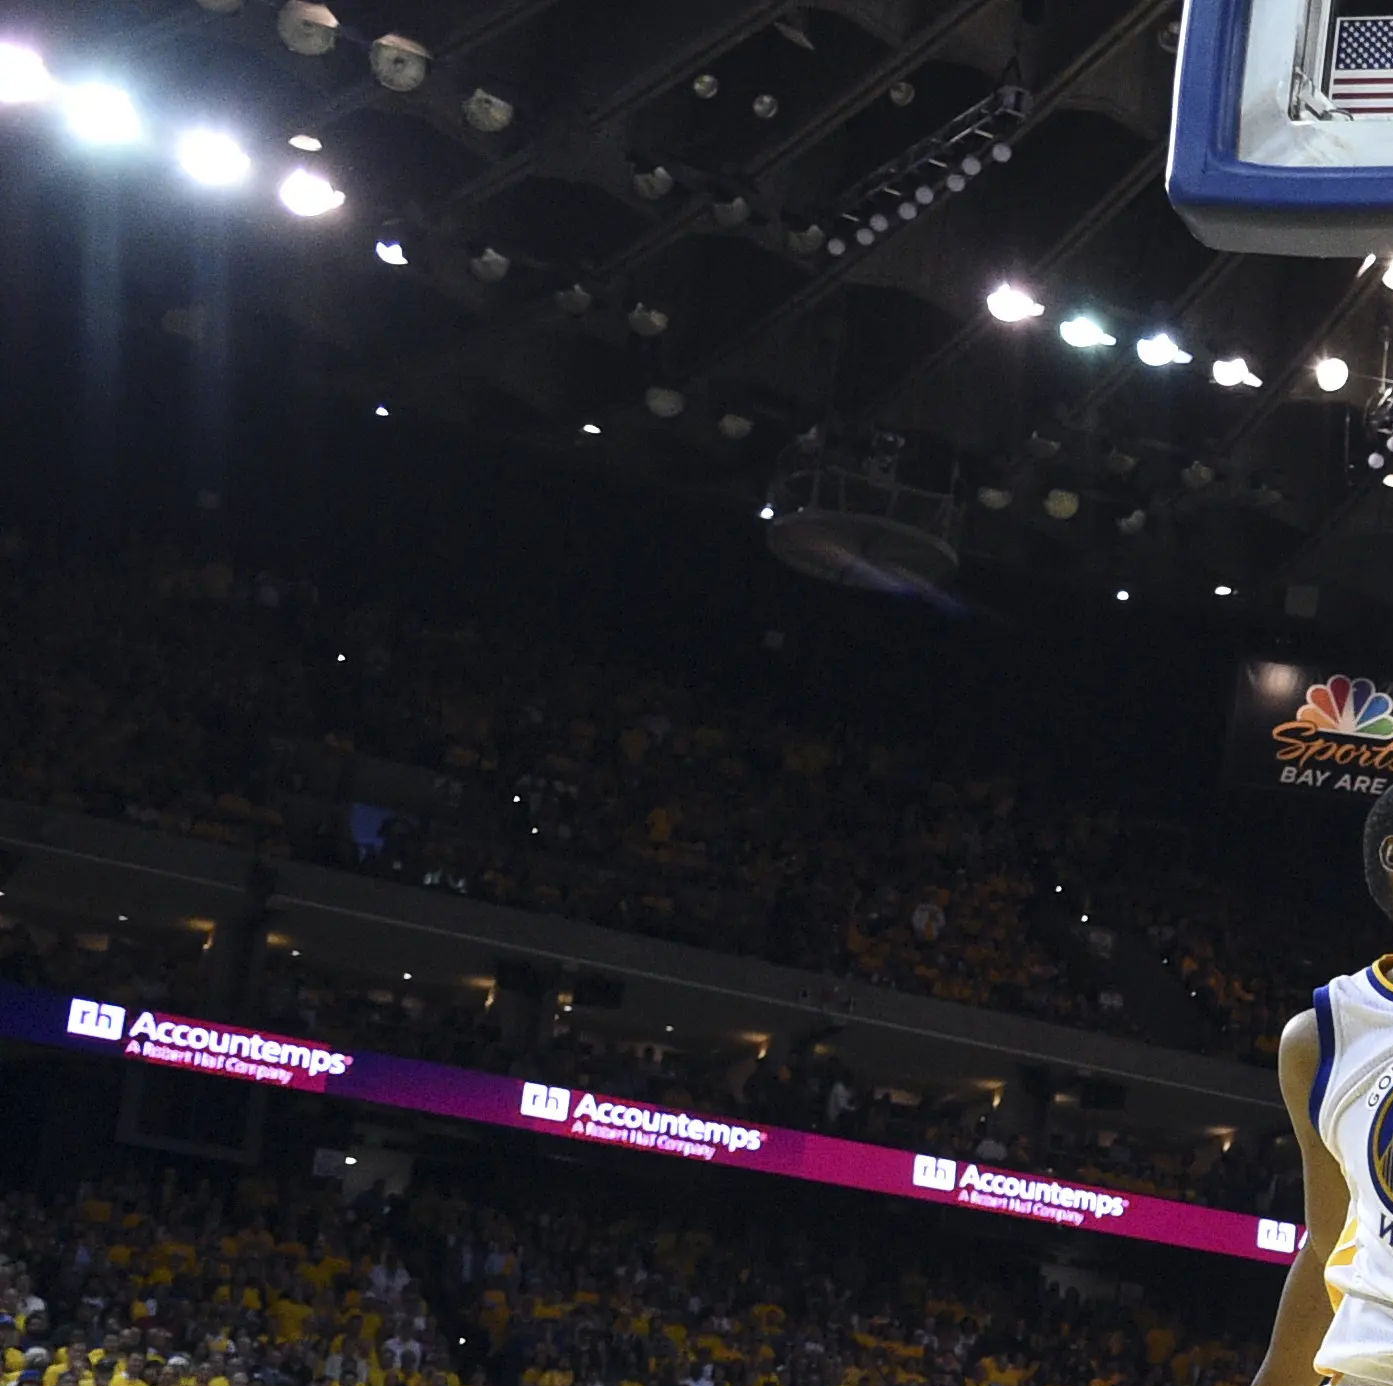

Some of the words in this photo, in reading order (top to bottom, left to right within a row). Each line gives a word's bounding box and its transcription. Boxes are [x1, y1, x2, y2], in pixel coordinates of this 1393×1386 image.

[1279, 766, 1332, 787] BAY
[125, 1040, 141, 1053] A
[129, 1011, 346, 1076] Accountemps
[571, 1120, 585, 1134] A
[573, 1093, 761, 1152] Accountemps
[958, 1189, 970, 1202] A
[959, 1163, 1123, 1218] Accountemps
